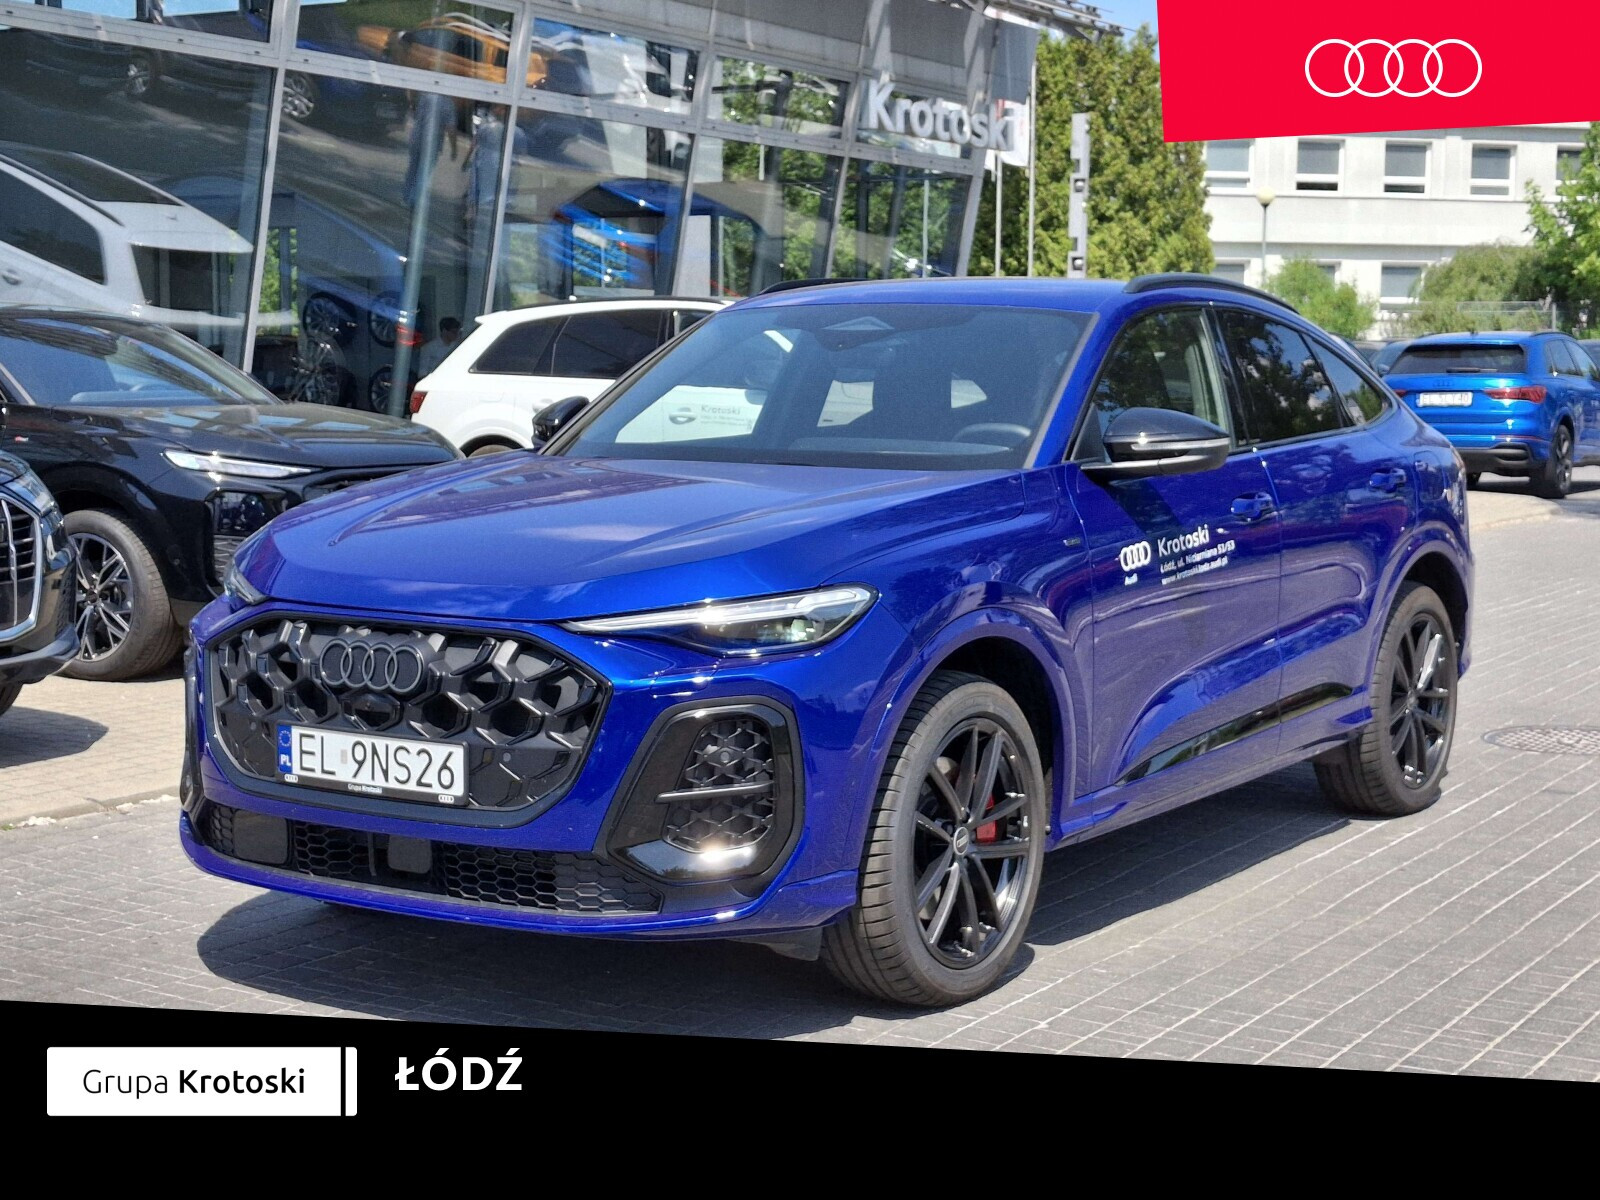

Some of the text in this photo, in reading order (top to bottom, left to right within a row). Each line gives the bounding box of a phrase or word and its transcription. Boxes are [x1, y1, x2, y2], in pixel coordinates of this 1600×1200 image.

[867, 78, 1015, 152] Krotoski
[1157, 524, 1210, 557] Krotoski
[280, 754, 291, 767] PL
[299, 733, 455, 790] EL 9NS26
